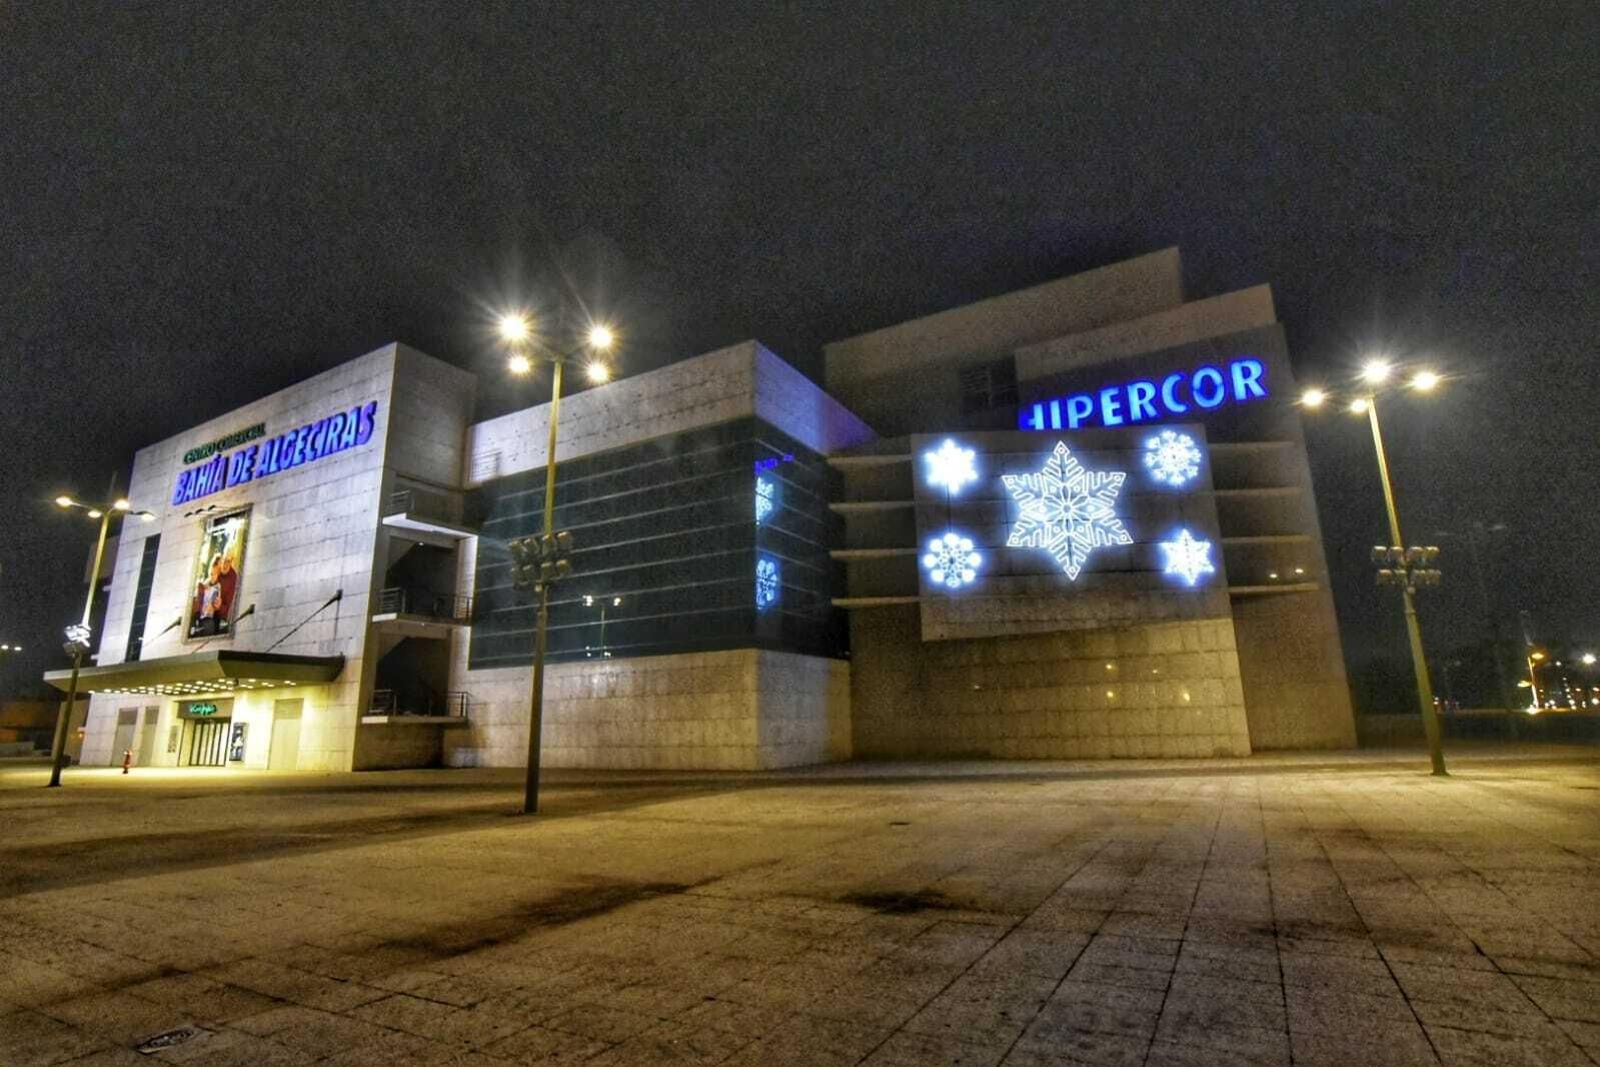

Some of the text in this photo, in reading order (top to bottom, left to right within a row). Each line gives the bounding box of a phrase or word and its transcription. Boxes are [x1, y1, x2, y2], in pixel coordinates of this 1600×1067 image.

[172, 400, 378, 506] BAHÍA DE ALGECIRAS
